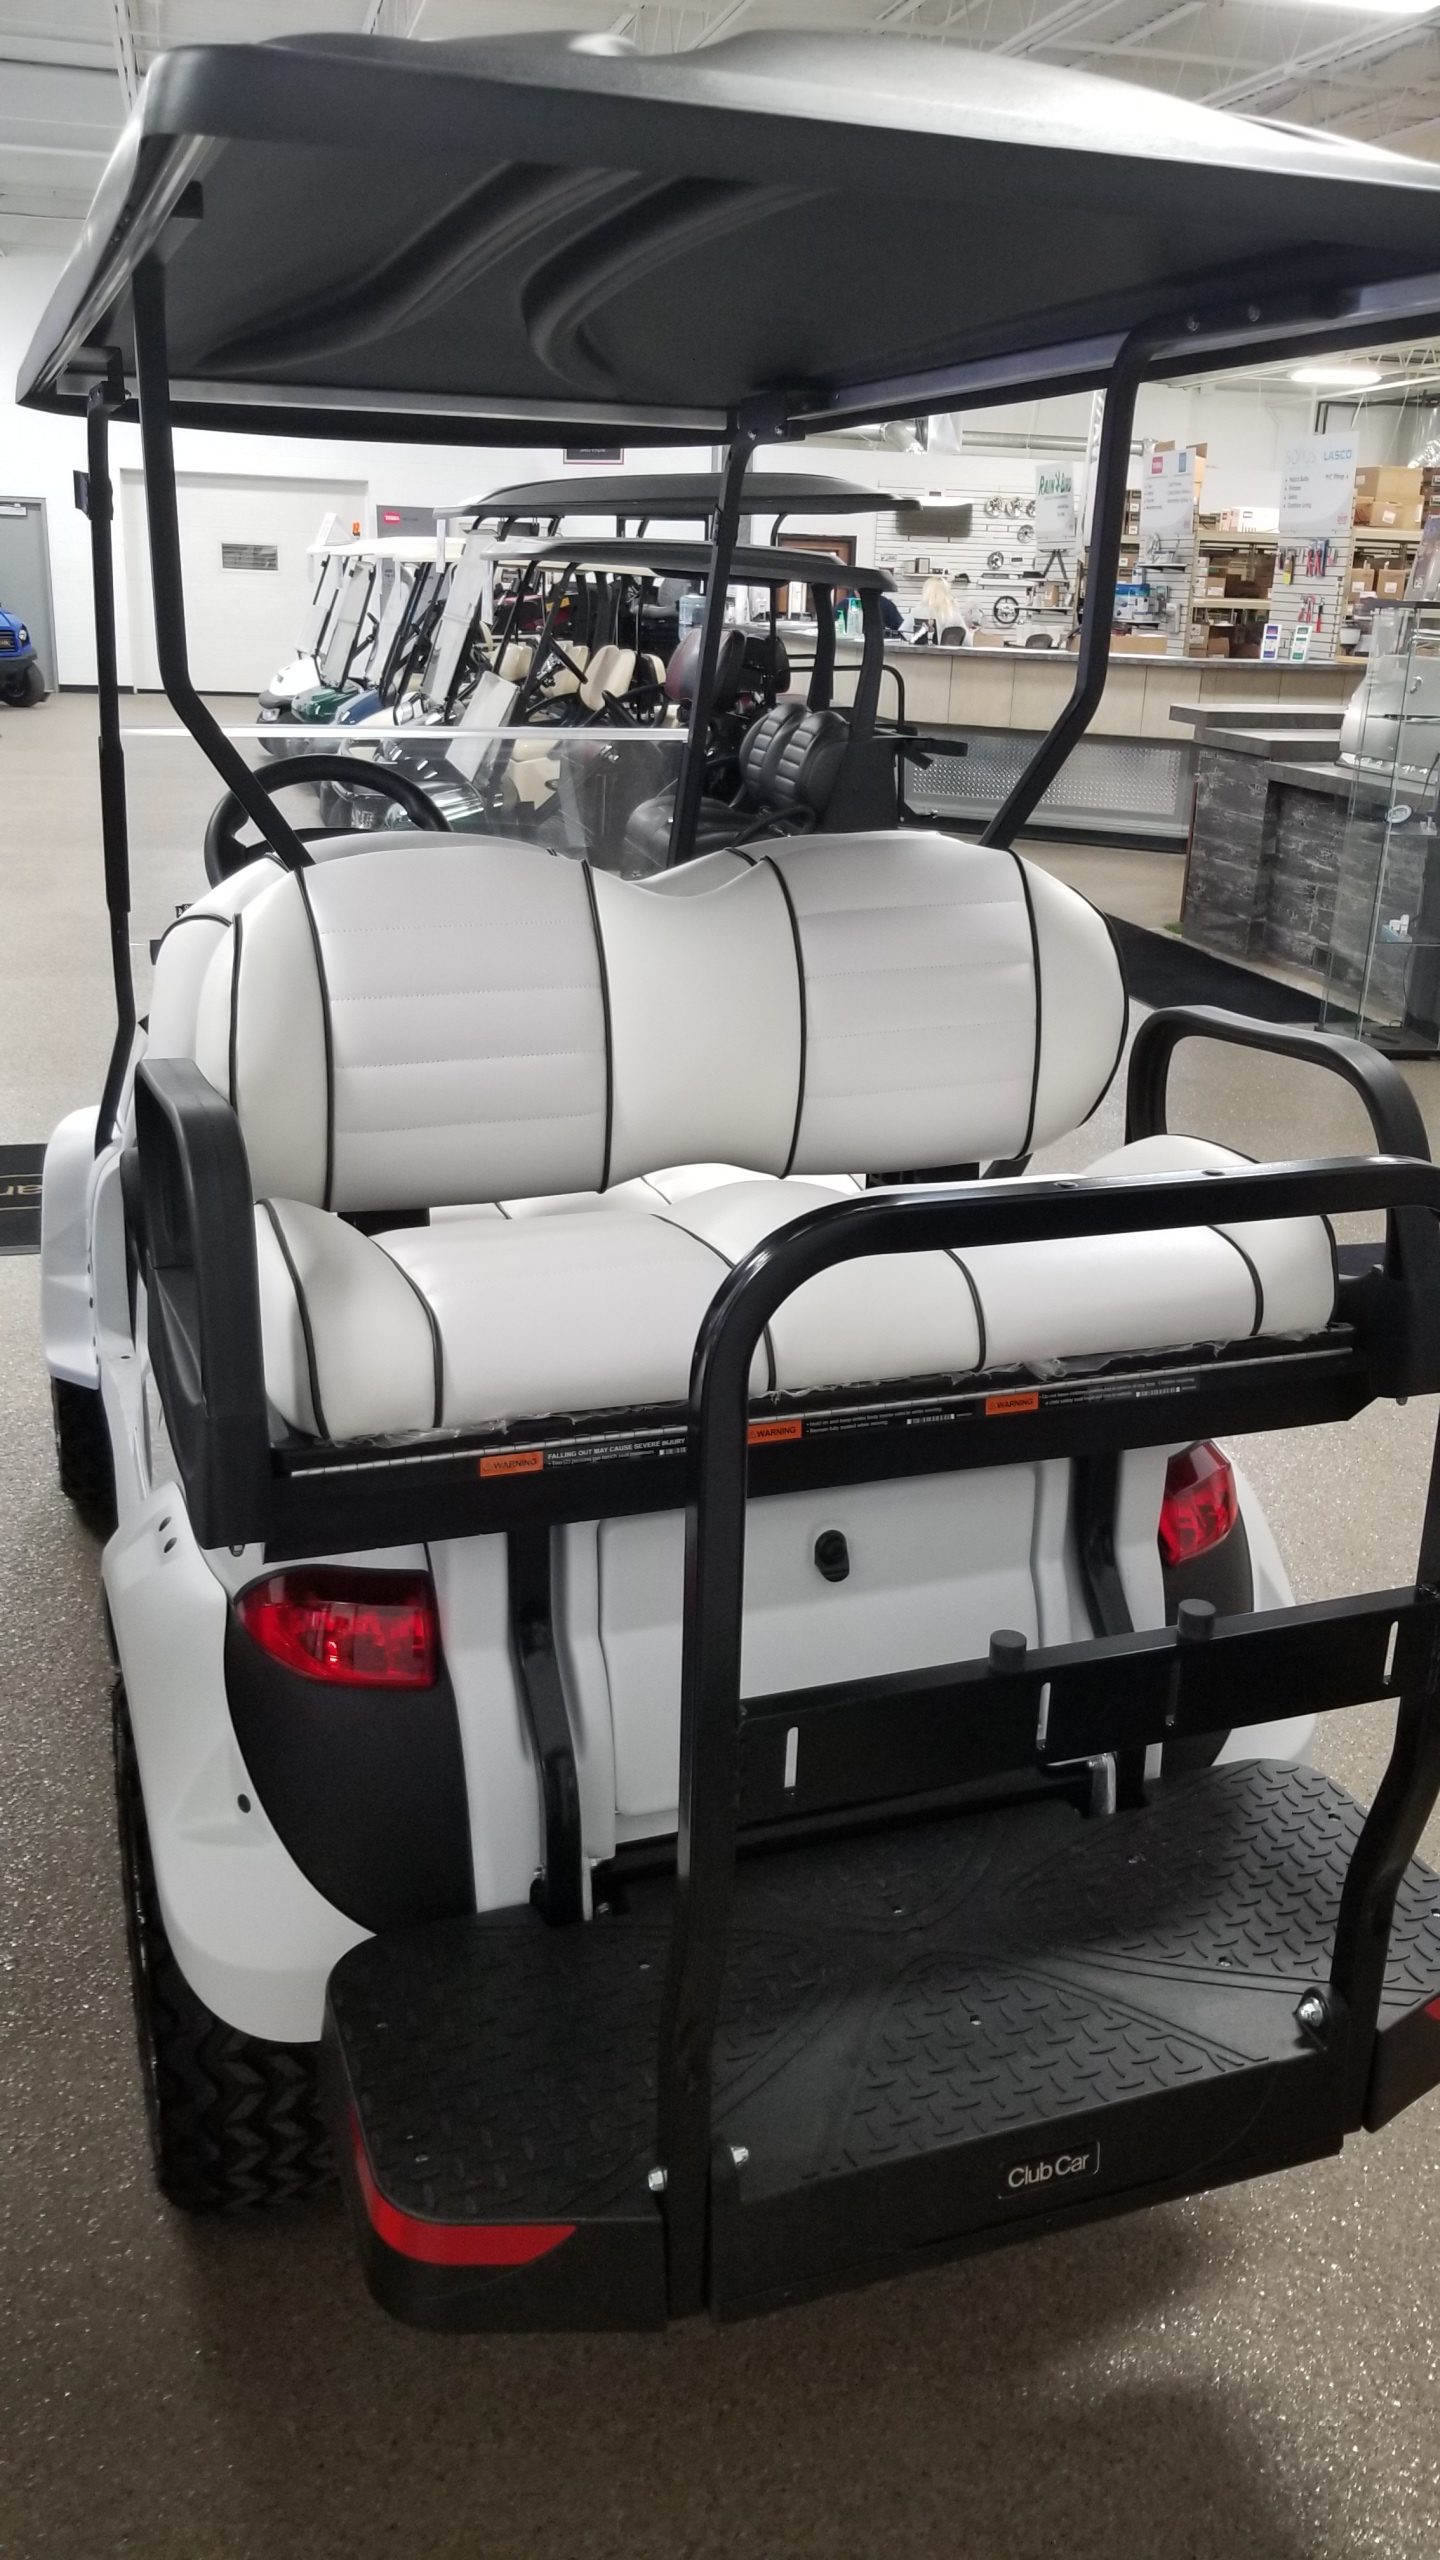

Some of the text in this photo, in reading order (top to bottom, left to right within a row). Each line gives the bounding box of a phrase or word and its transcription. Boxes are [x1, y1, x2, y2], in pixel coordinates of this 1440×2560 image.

[1038, 475, 1055, 496] RAIN
[996, 1397, 1034, 1409] WARNING
[757, 1426, 797, 1437] WARNING
[547, 1437, 685, 1459] FALLING OUT MAY CAUSE SEVERE INJURY
[493, 1457, 538, 1470] WARNING
[1008, 2153, 1090, 2188] Club Car
